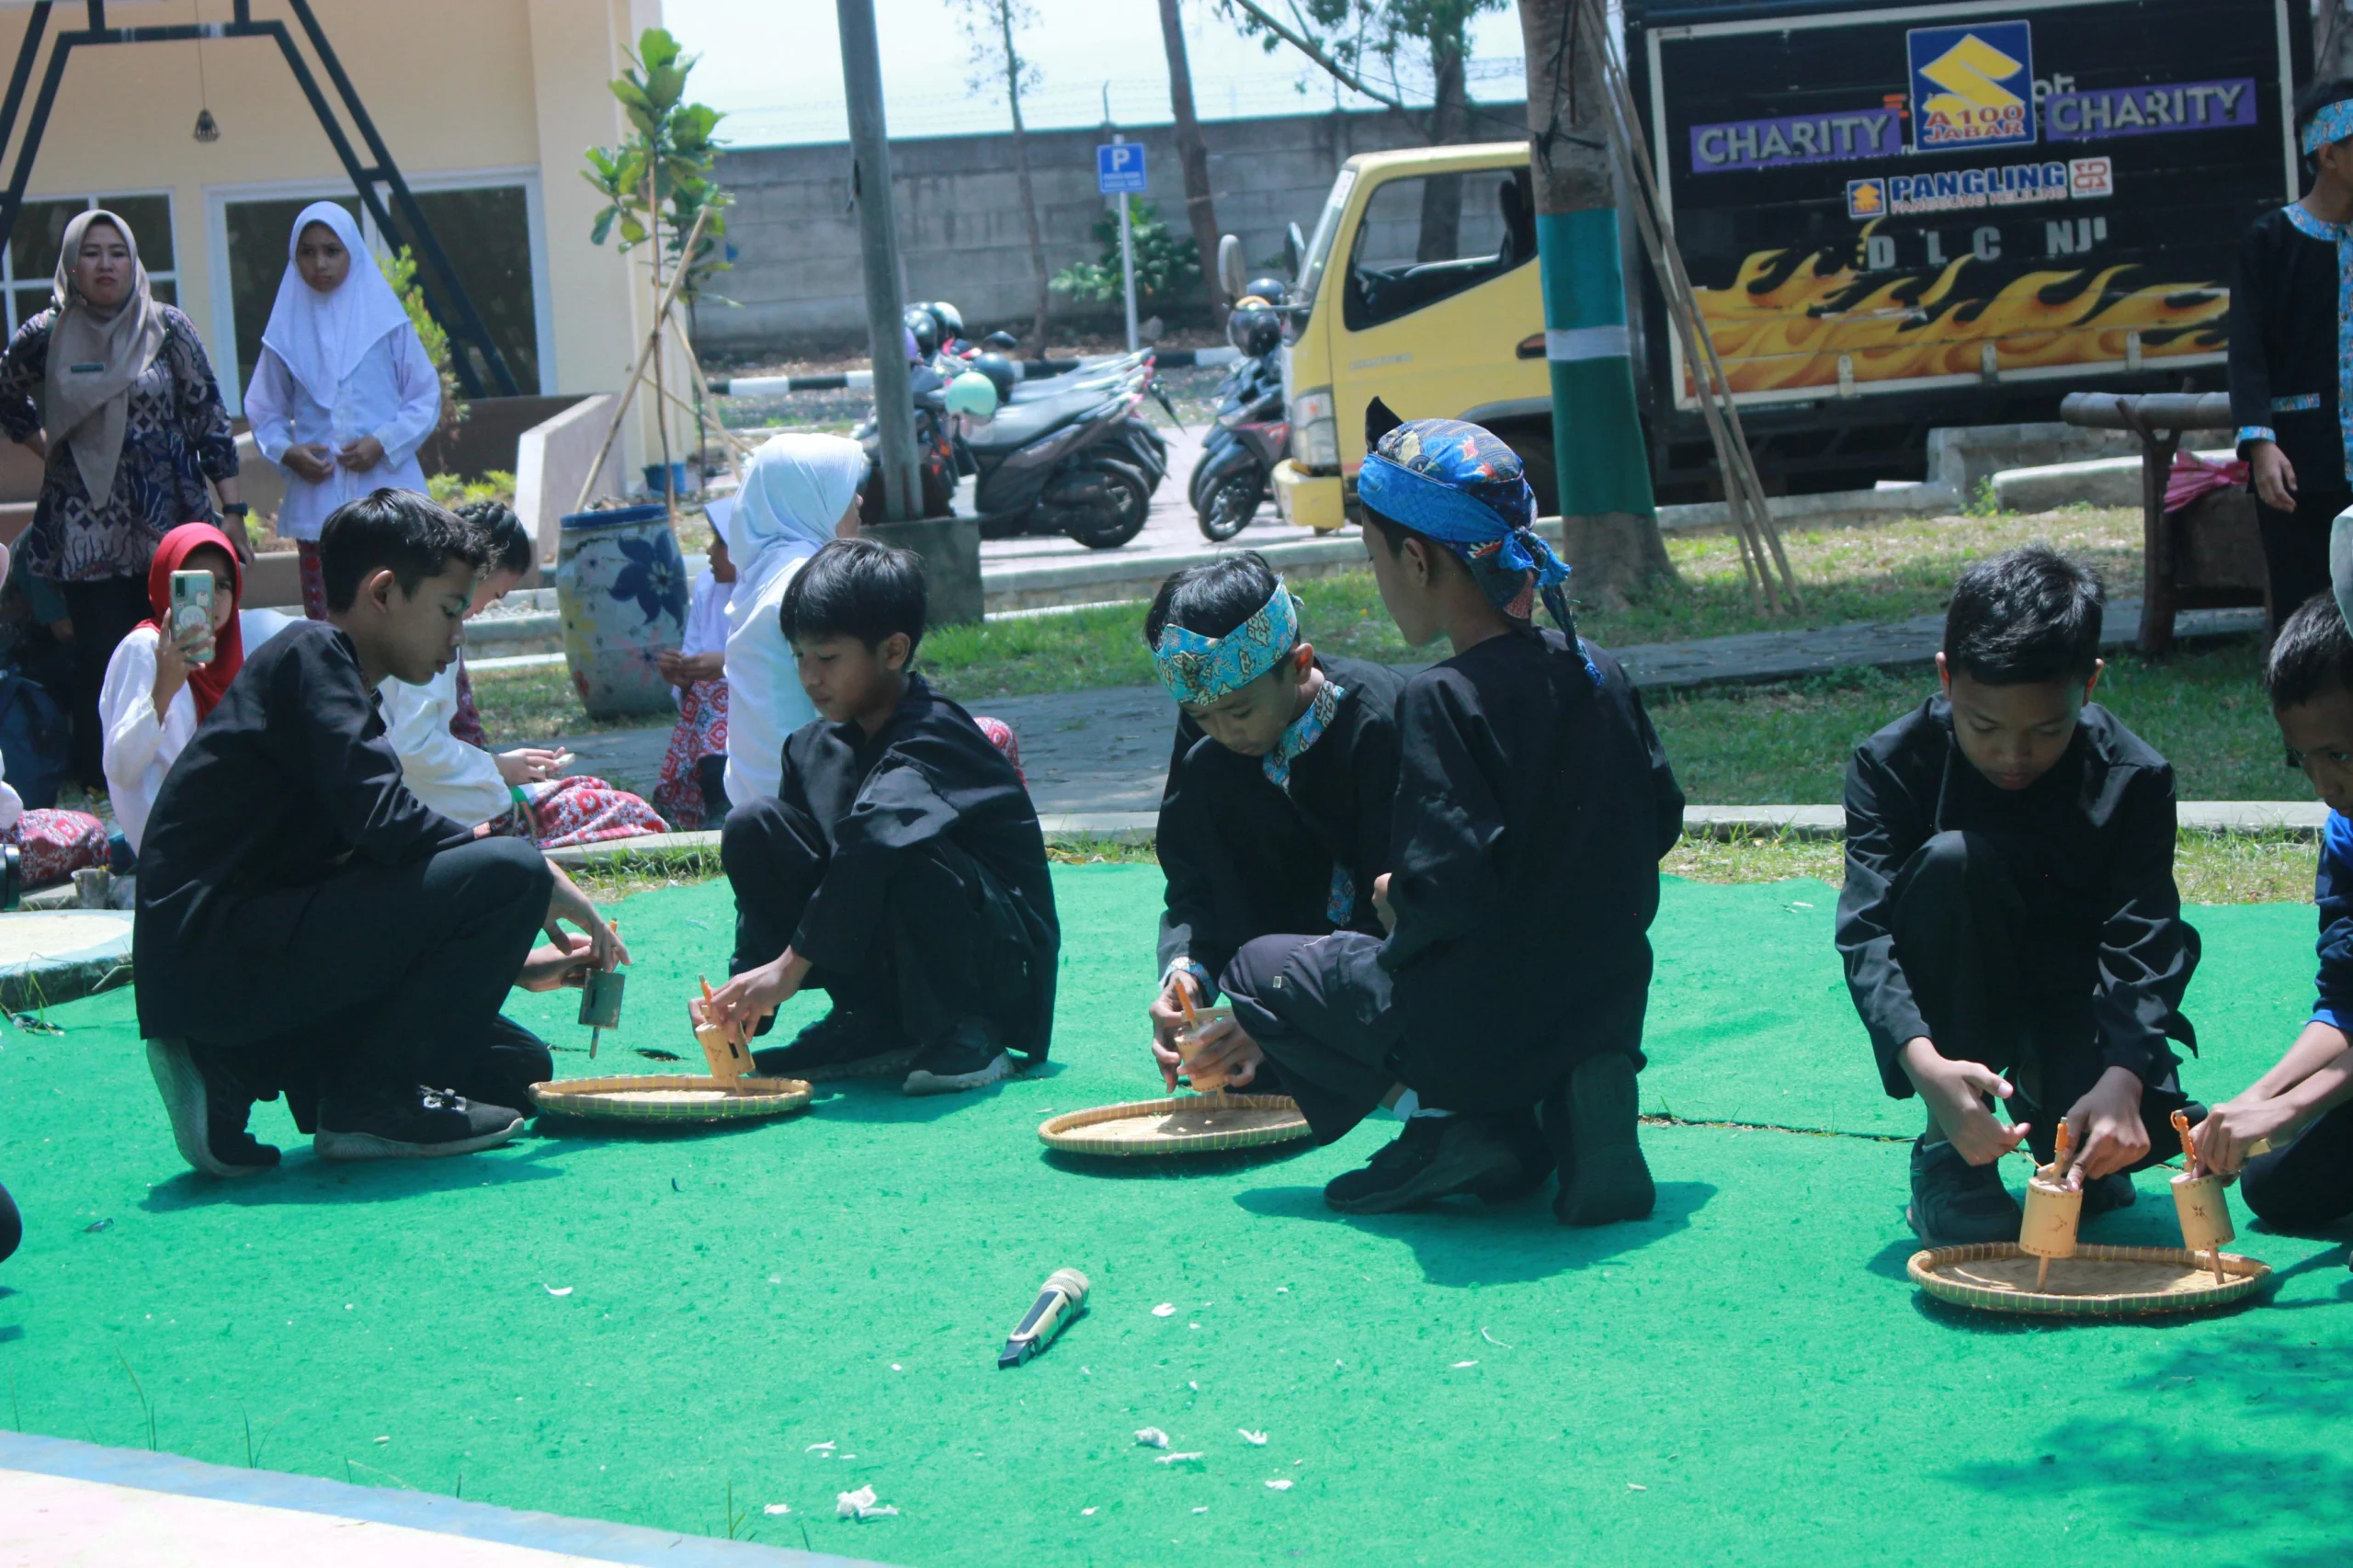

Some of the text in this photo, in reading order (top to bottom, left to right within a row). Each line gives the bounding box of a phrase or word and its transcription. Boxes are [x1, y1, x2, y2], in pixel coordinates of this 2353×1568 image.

[1927, 104, 2026, 128] A100
[2051, 83, 2245, 133] CHARITY
[1698, 114, 1892, 165] CHARITY
[1924, 121, 2026, 143] JABAR
[1112, 148, 1131, 172] P
[1888, 161, 2068, 201] PANGLING
